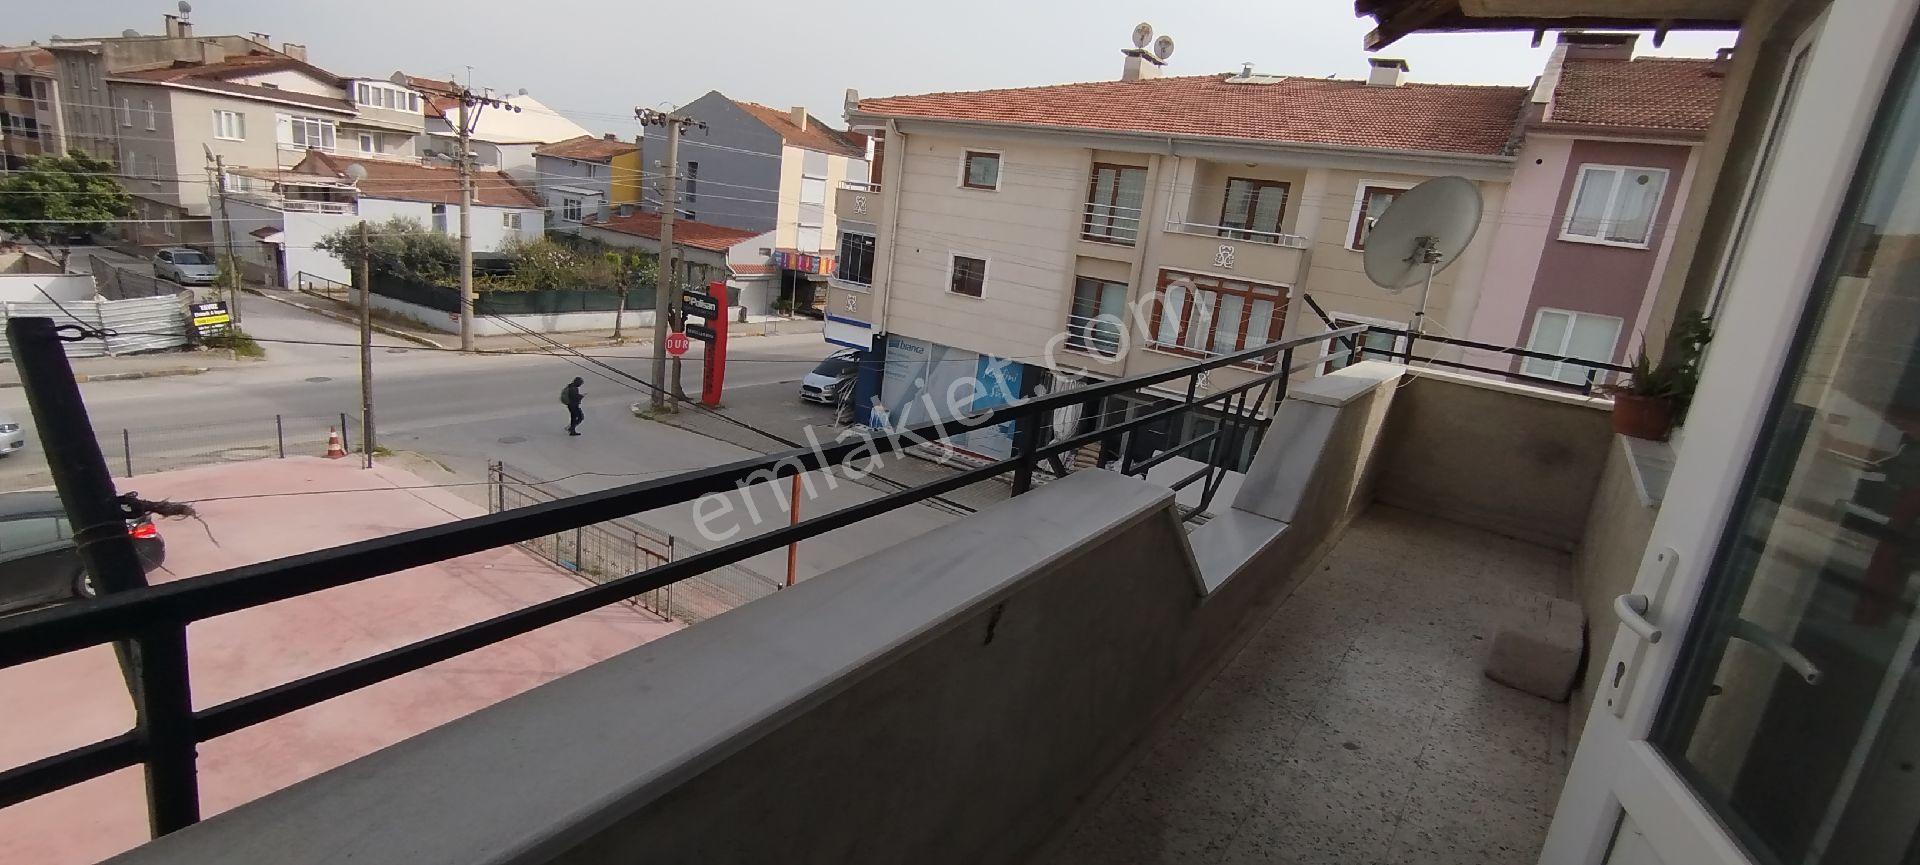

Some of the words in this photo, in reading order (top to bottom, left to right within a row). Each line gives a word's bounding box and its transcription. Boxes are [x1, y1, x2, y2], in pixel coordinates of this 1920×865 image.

[690, 297, 715, 310] Polisan
[667, 339, 689, 349] DUR
[900, 340, 924, 353] bianca
